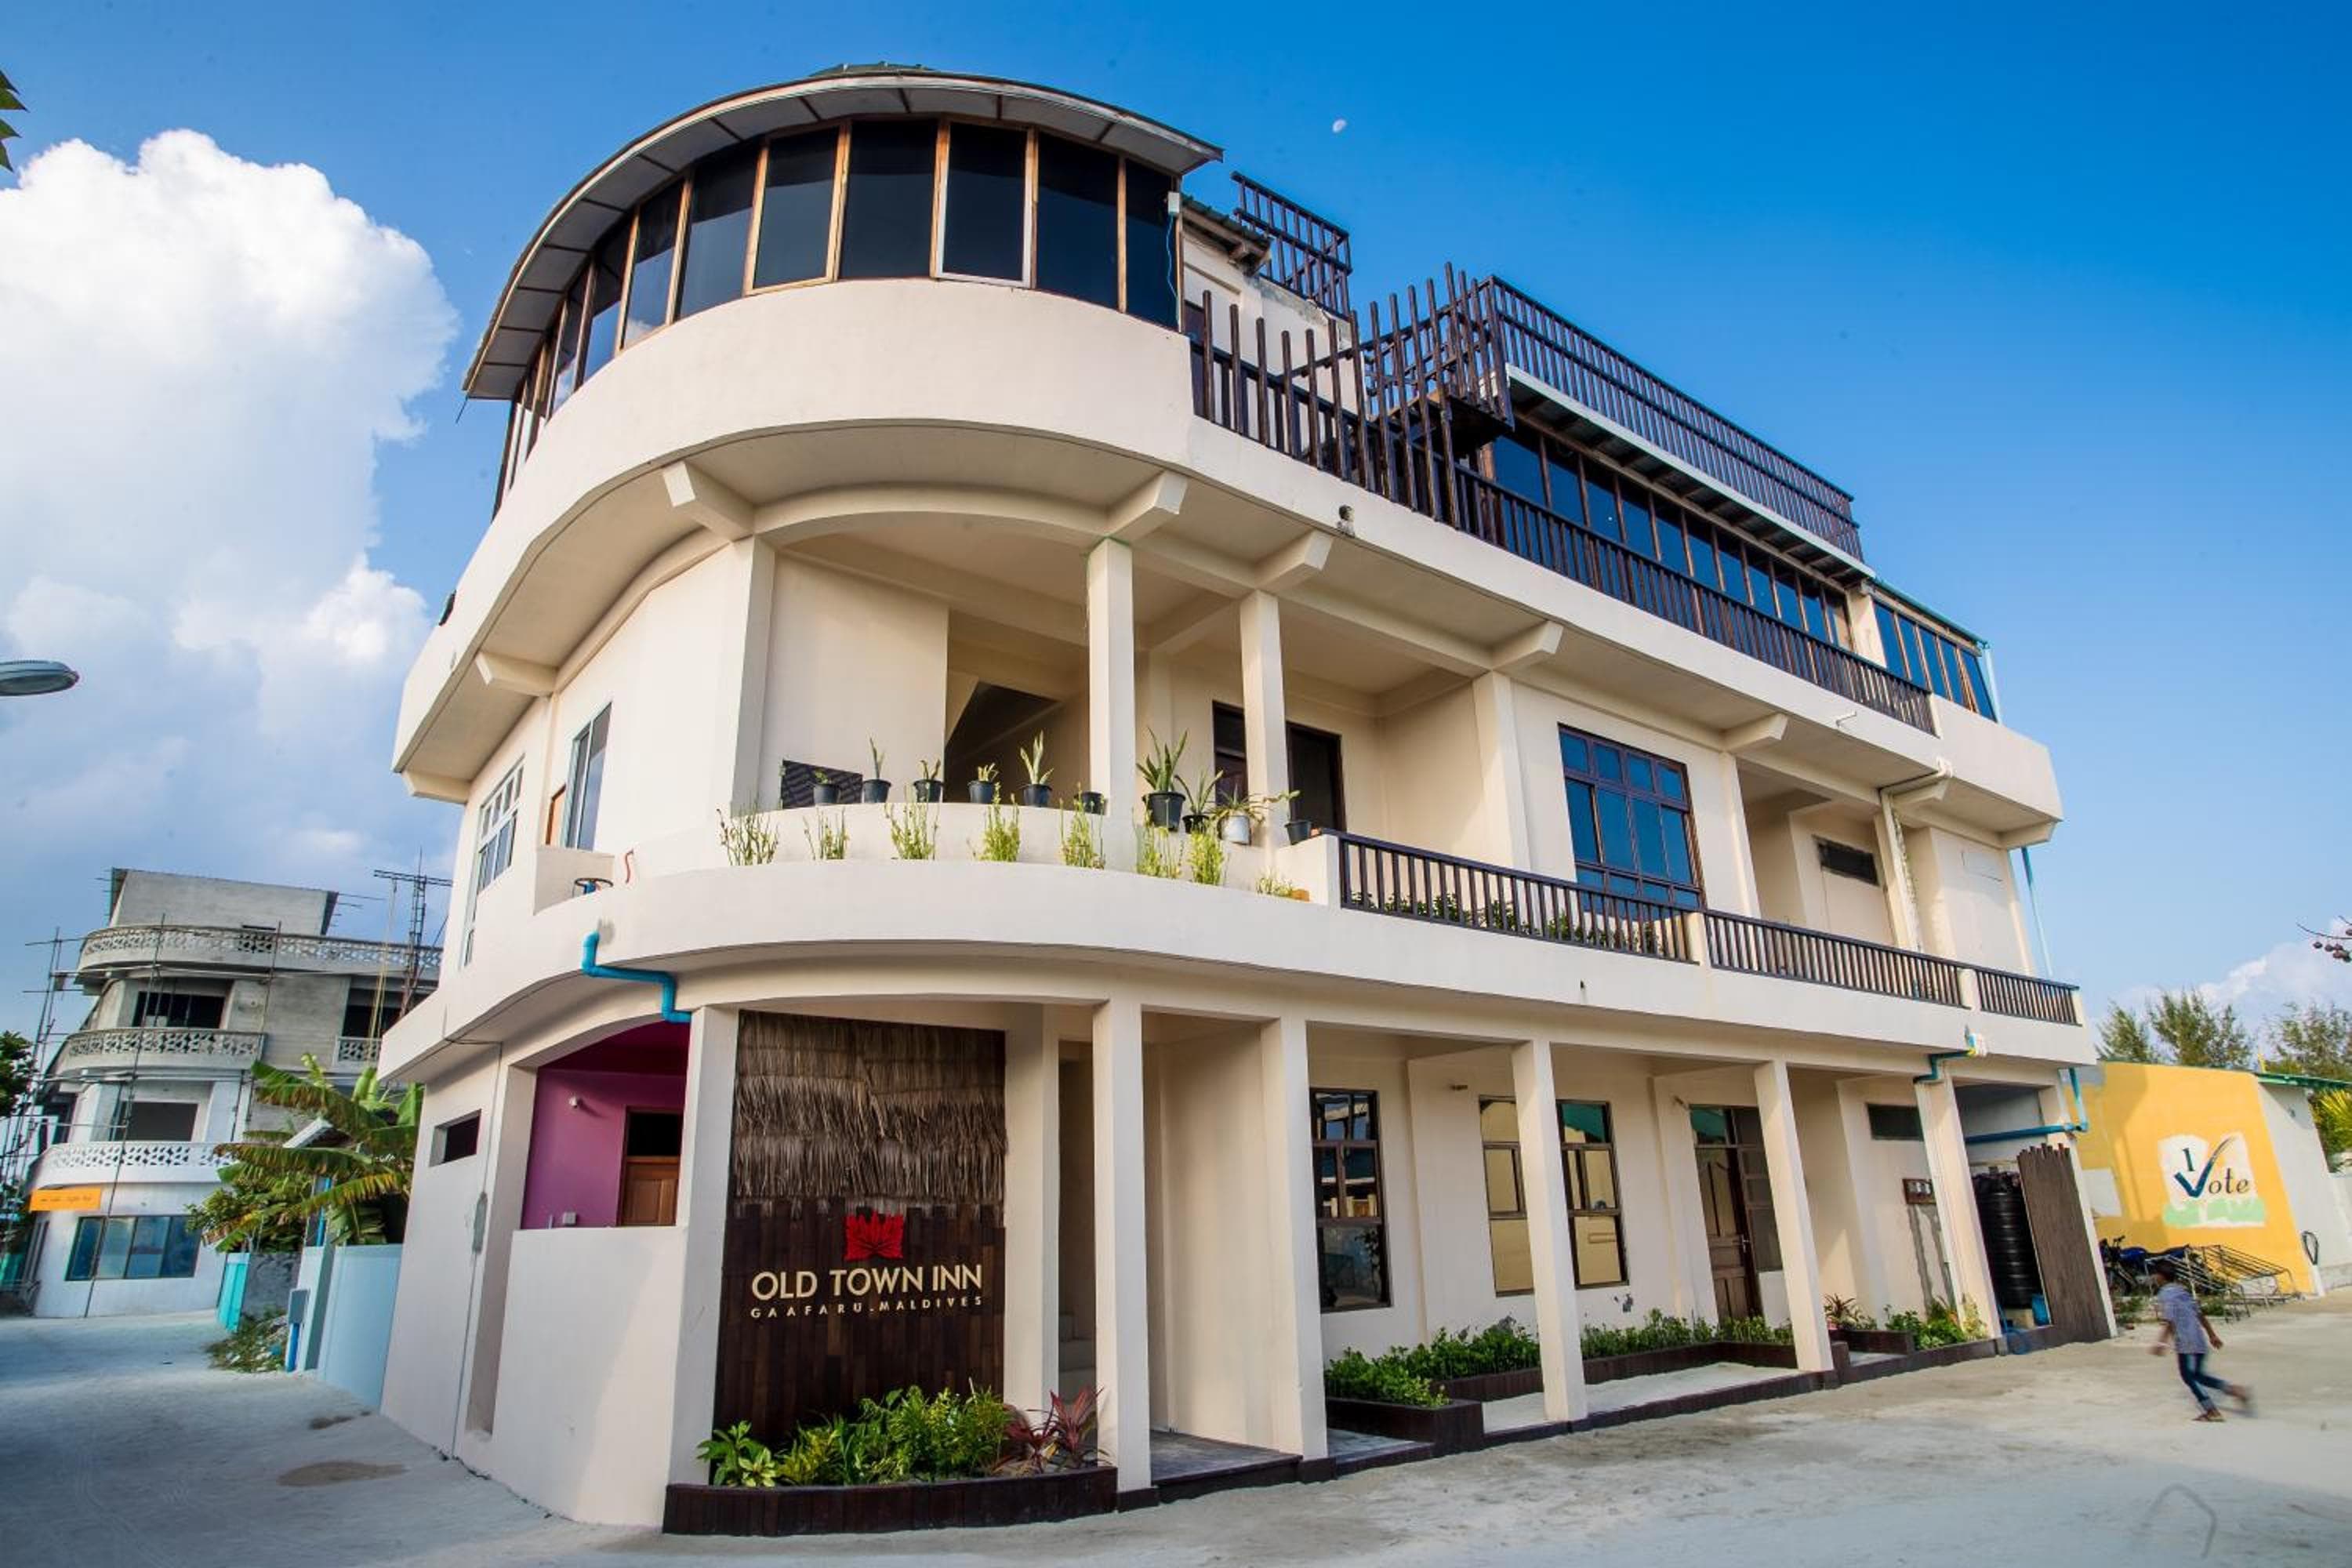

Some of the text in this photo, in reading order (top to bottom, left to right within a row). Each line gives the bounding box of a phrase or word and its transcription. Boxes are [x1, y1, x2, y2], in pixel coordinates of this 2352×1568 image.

[2174, 1136, 2249, 1198] Vote
[752, 1264, 982, 1301] OLD TOWN INN
